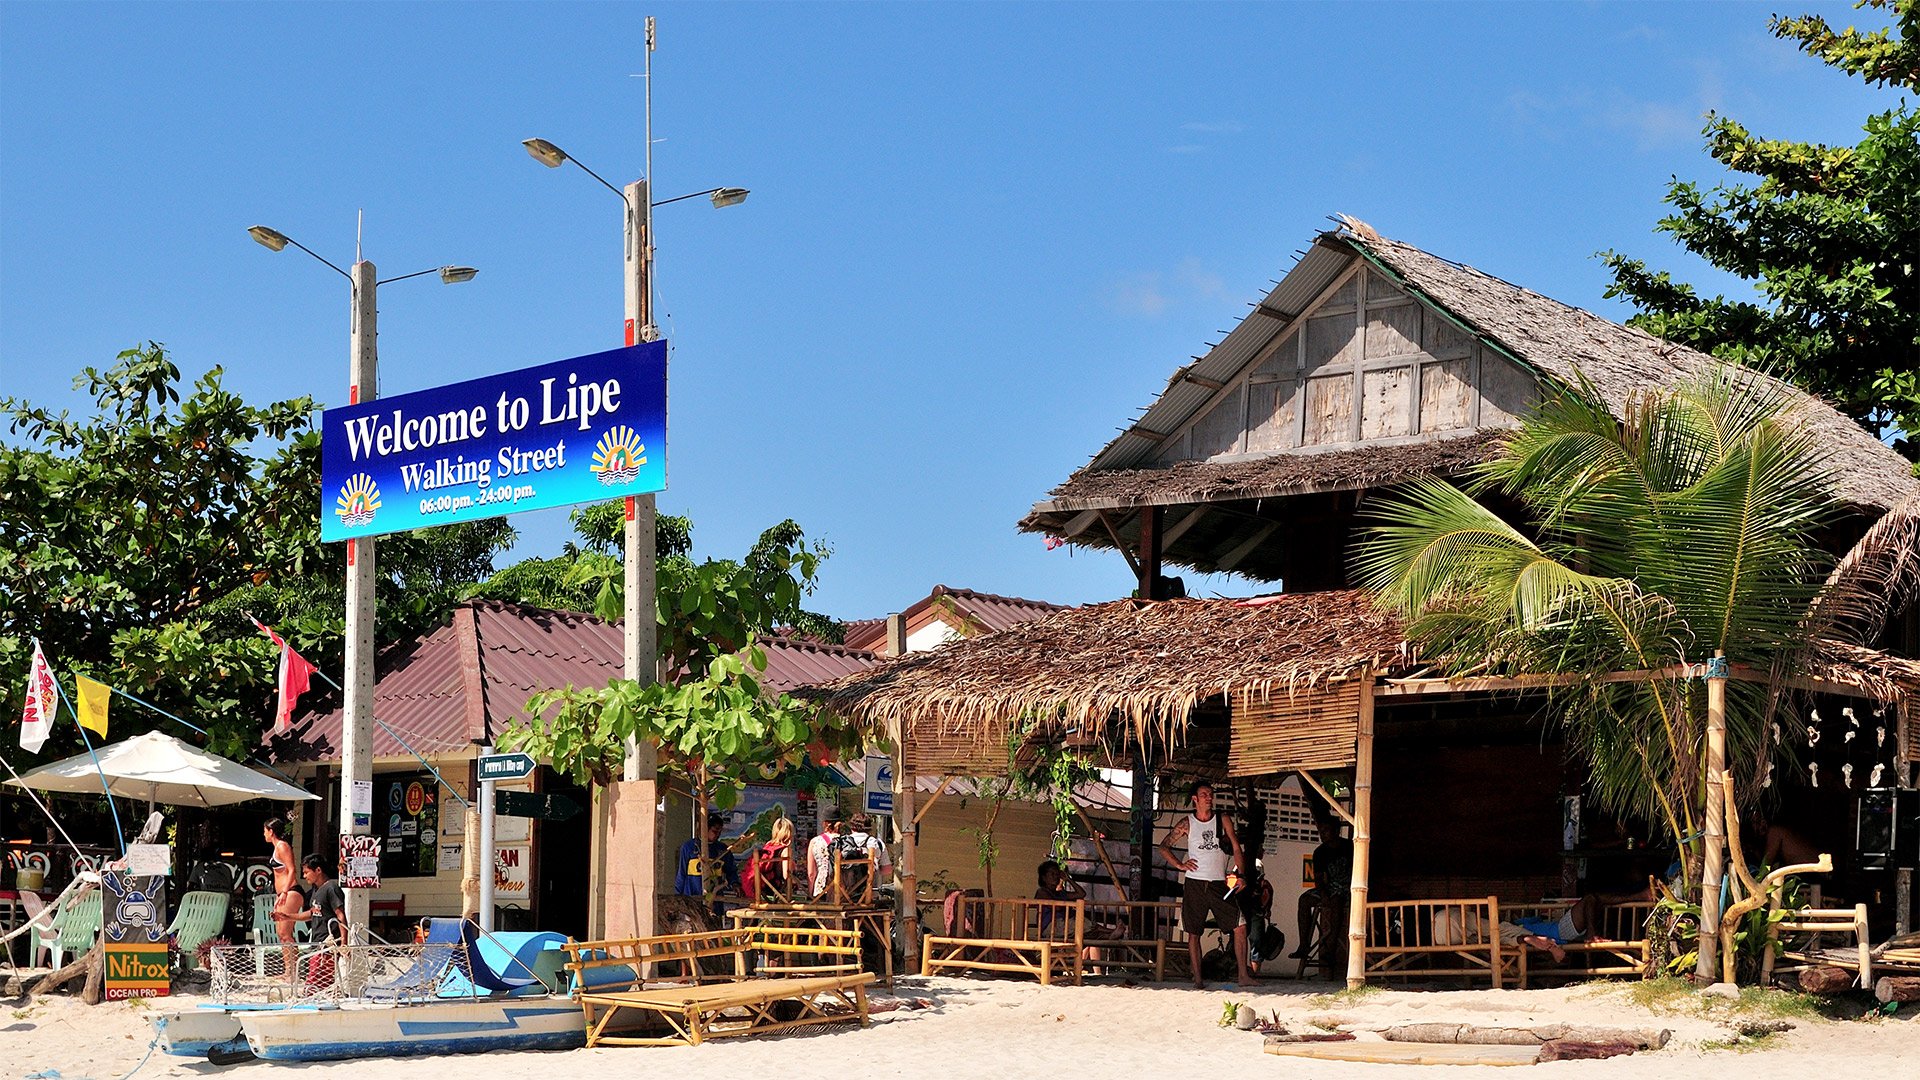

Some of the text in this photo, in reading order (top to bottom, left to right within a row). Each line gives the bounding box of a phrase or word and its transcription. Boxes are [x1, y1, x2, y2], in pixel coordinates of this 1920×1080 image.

[344, 372, 621, 462] Welcome to Lipe
[400, 439, 566, 493] Walking Street
[420, 495, 451, 514] 06:00
[452, 495, 474, 514] pm.
[513, 484, 536, 504] pm.
[351, 849, 374, 857] TIME
[109, 954, 169, 977] Nitrox
[109, 988, 157, 998] OCEAN PRO
